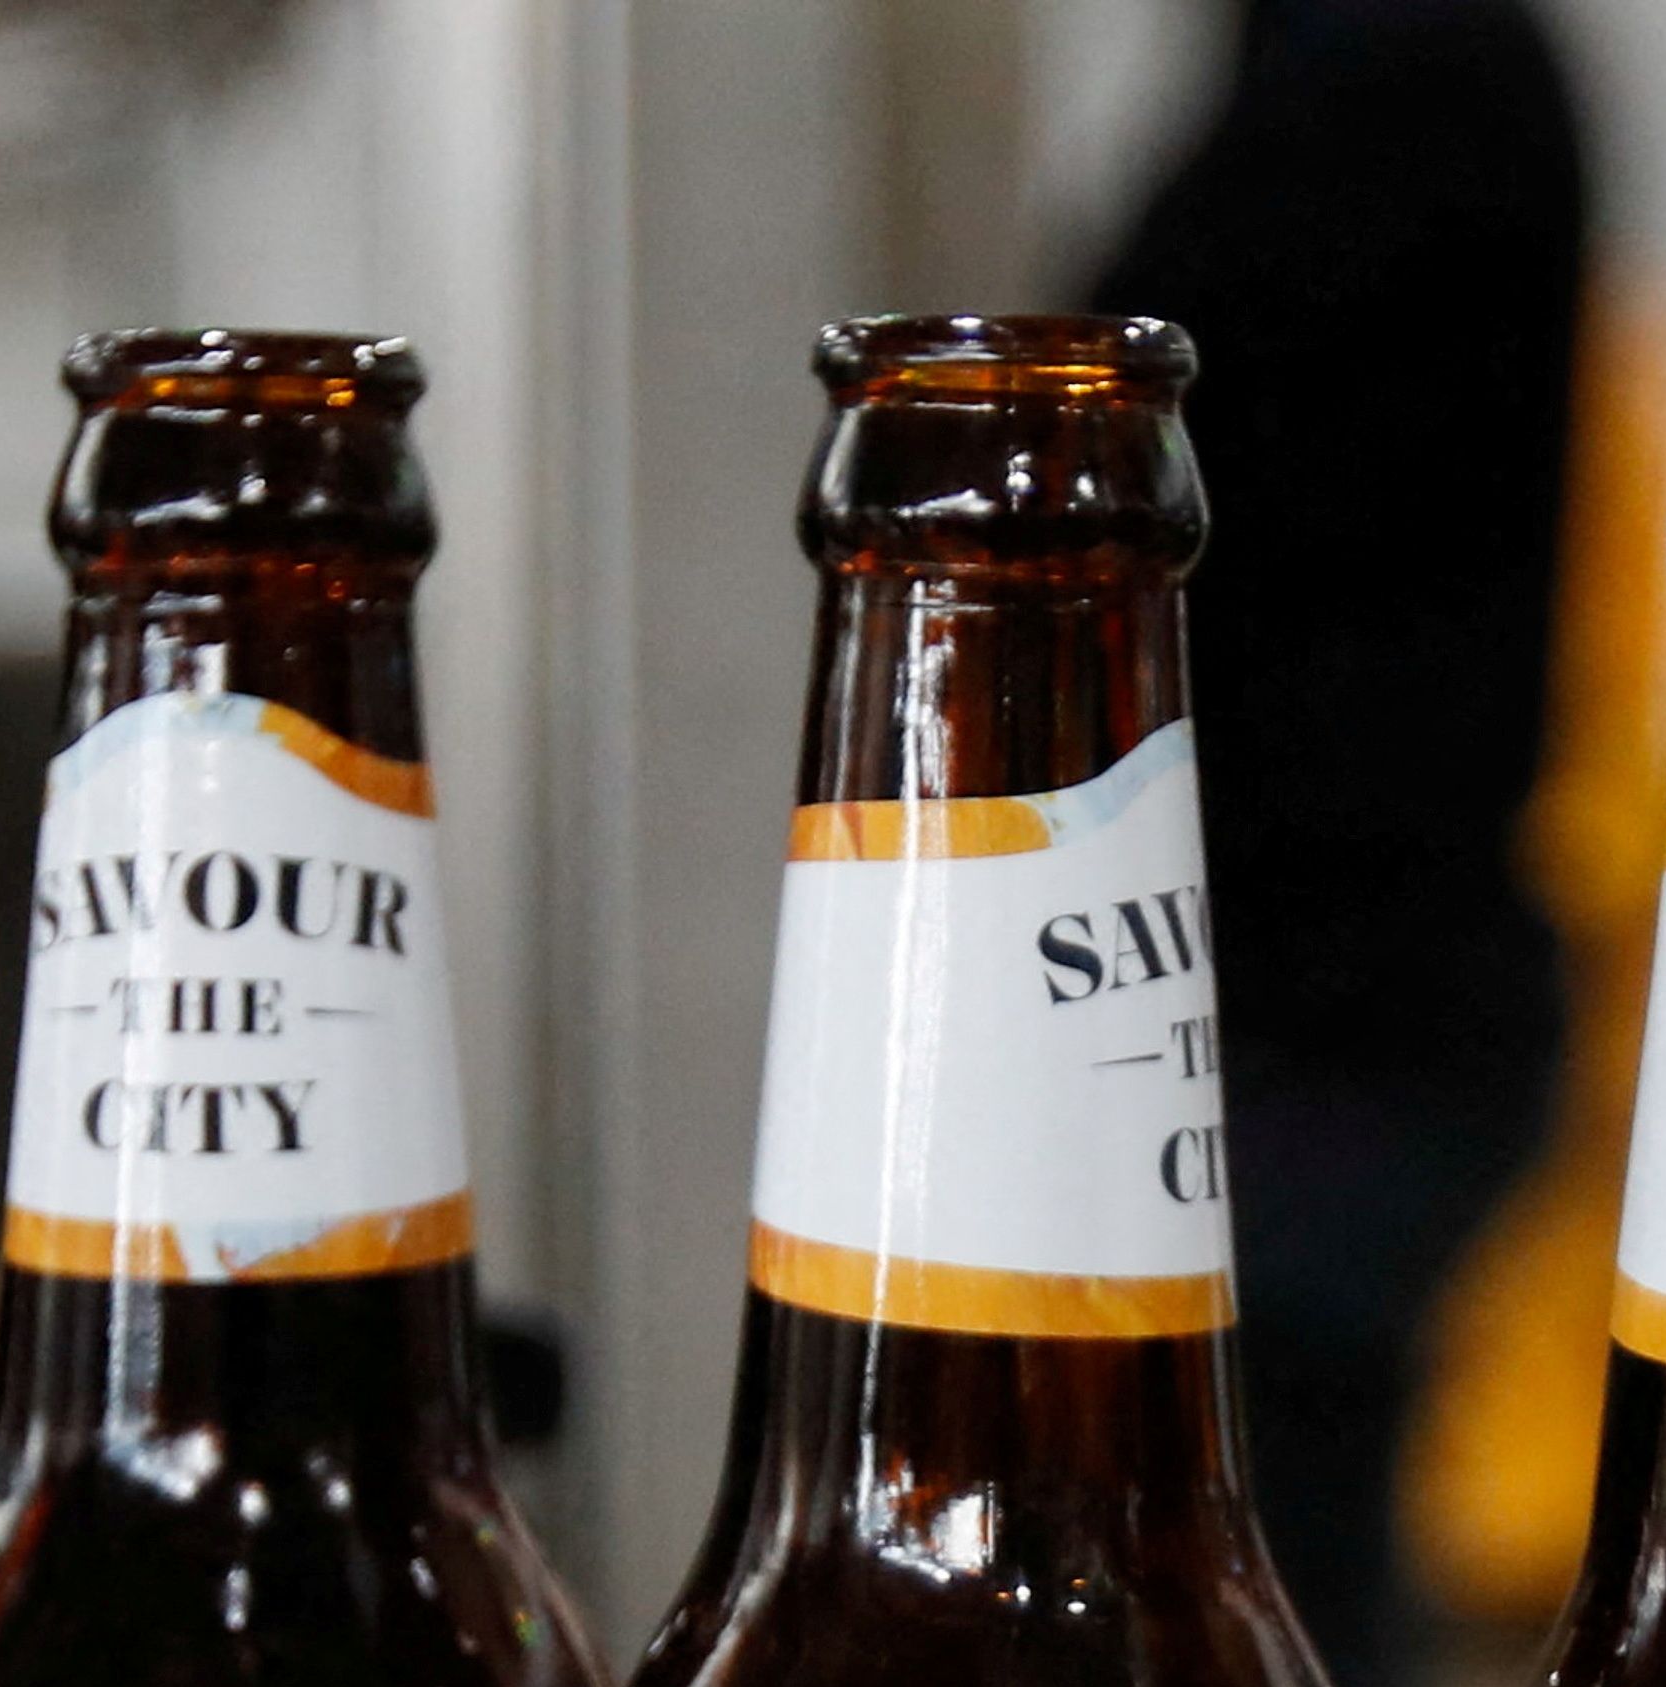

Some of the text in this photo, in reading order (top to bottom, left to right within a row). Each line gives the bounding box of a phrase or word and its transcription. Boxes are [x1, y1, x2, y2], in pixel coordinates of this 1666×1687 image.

[33, 850, 410, 957] SAVOUR
[1037, 885, 1213, 1005] SAV
[110, 977, 283, 1036] THE
[82, 1078, 317, 1156] CITY
